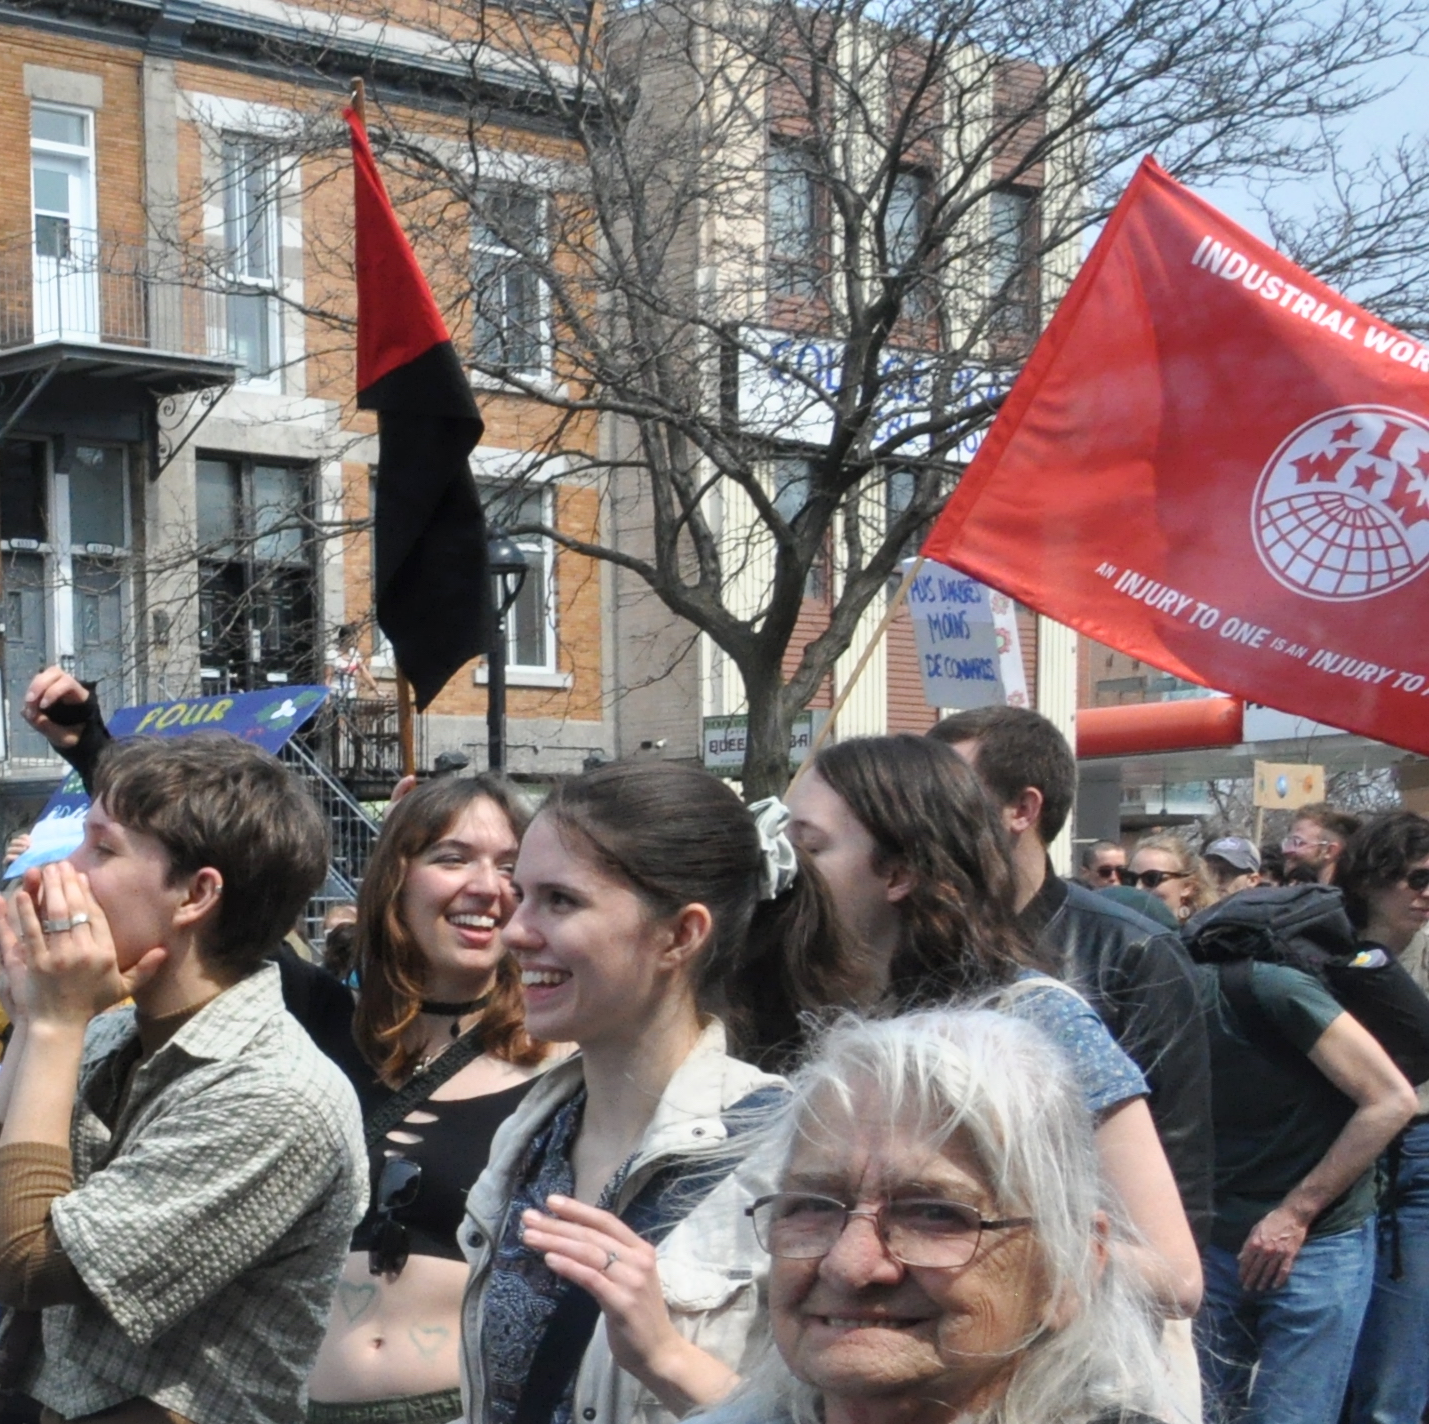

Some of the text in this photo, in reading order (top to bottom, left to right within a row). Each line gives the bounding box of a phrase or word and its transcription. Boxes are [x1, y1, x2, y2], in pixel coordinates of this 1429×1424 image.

[1191, 235, 1358, 341] INDUSTRIAL
[1095, 561, 1117, 579] AN
[1113, 569, 1194, 617] INJURY
[1188, 602, 1221, 630] TO
[1219, 616, 1270, 649] ONE
[1270, 637, 1287, 652] IS
[1284, 643, 1308, 659] AN
[1308, 649, 1396, 685] INJURY
[1392, 671, 1425, 693] TO
[925, 653, 942, 678] DE
[134, 698, 235, 733] POUR
[709, 738, 747, 755] QUEE
